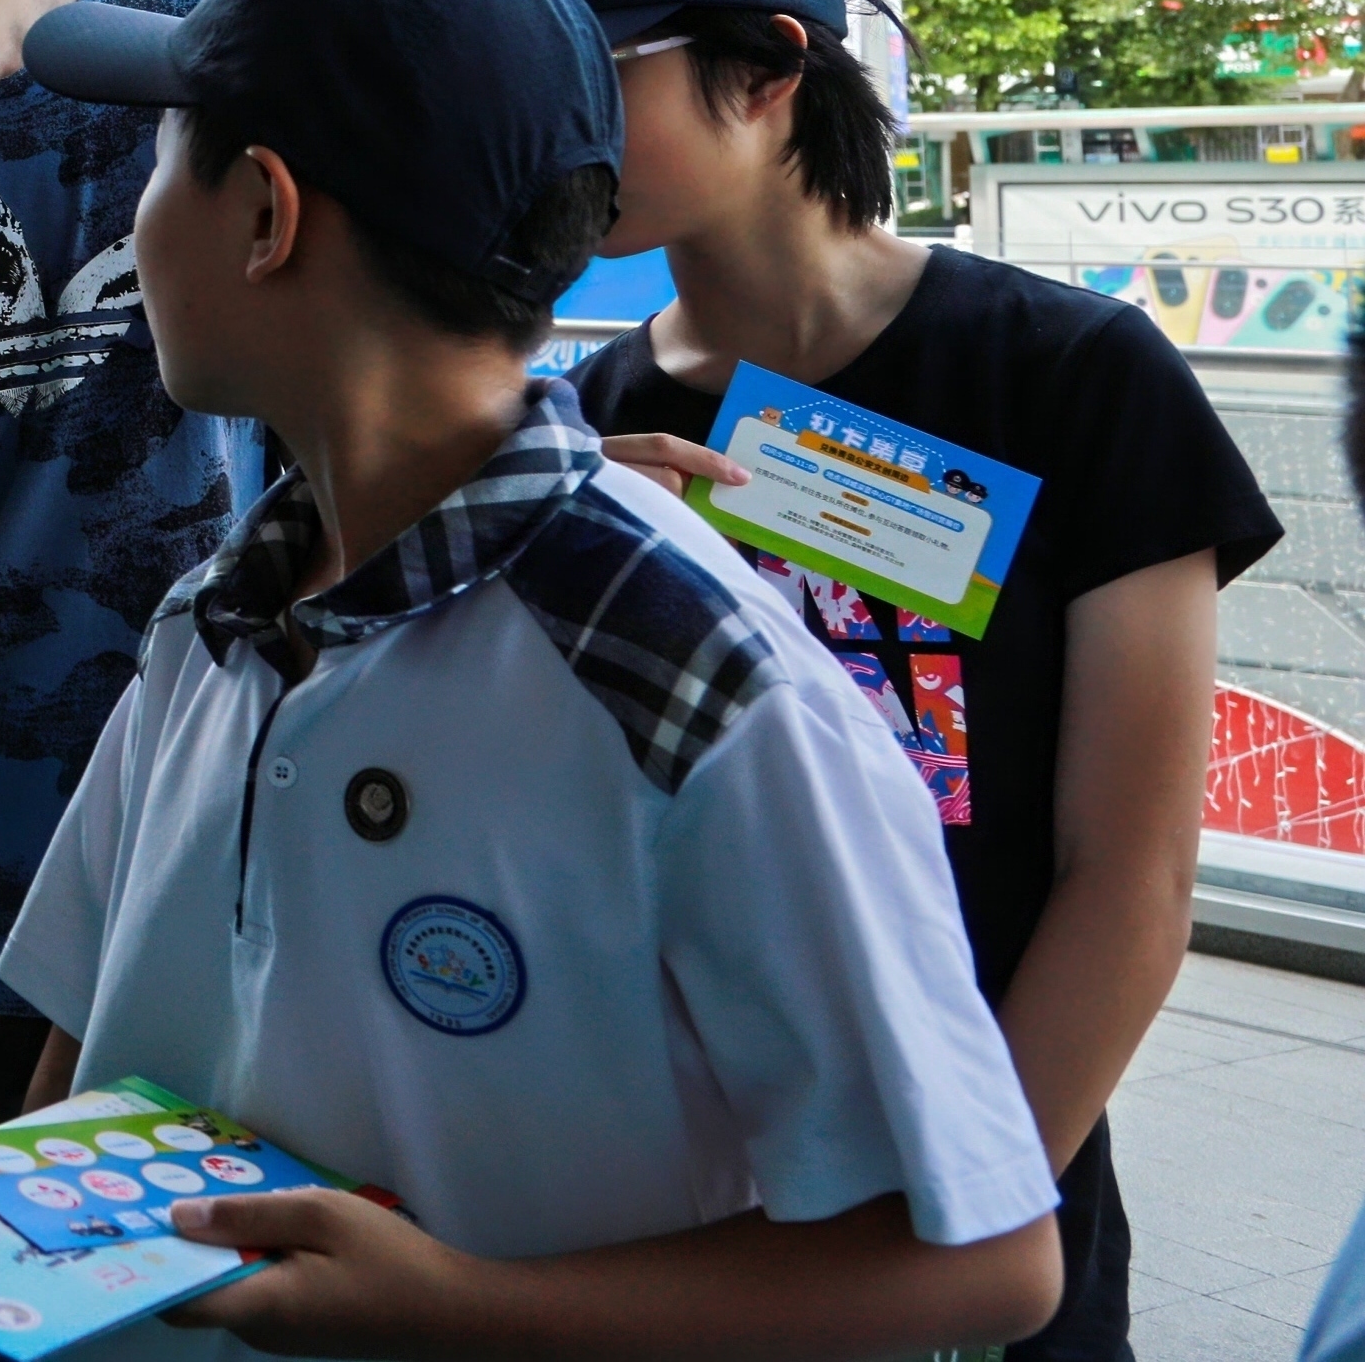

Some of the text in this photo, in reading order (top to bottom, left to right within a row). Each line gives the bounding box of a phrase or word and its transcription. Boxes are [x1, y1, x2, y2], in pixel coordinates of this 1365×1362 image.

[1077, 192, 1208, 223] vivo
[809, 410, 929, 475] 打卡集章
